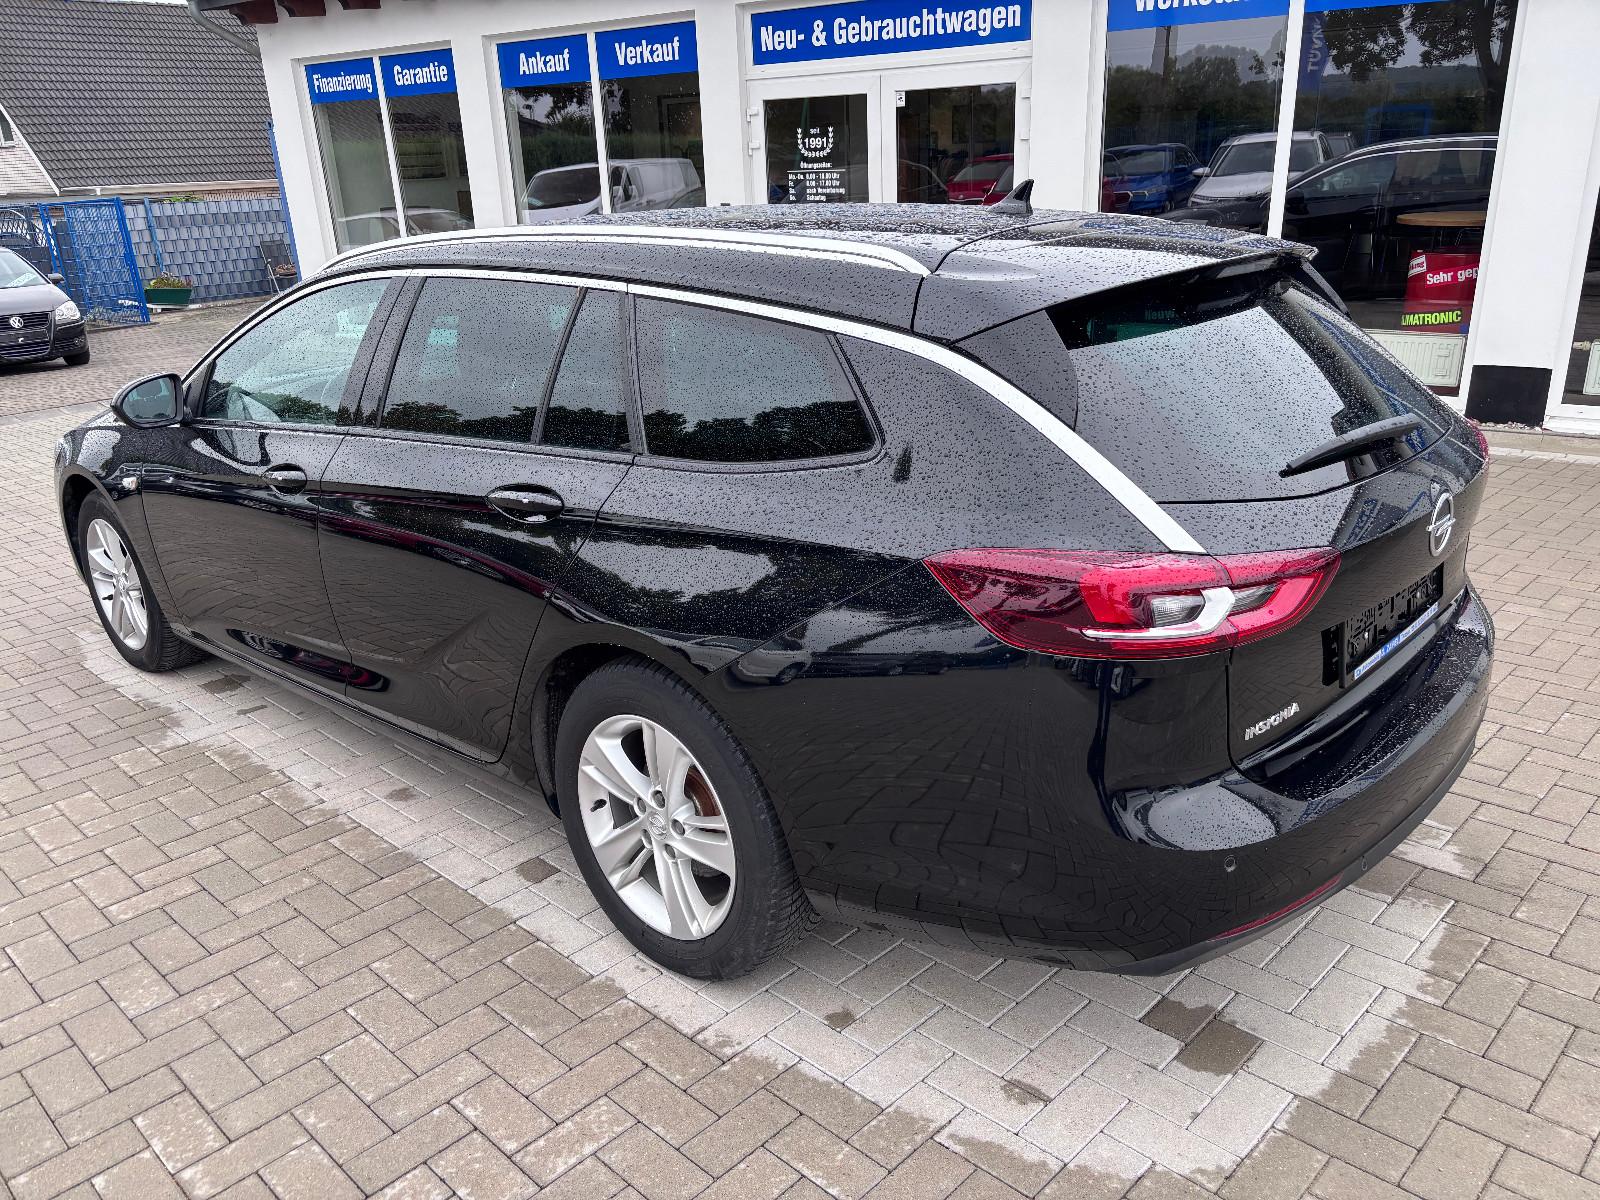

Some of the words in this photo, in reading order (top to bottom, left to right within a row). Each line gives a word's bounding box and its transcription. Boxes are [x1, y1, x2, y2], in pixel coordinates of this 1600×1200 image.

[760, 25, 805, 52] Neu-
[811, 19, 828, 47] &
[833, 3, 1021, 45] Gebrauchtwagen
[518, 47, 571, 75] Ankauf
[615, 36, 680, 66] Verkauf
[313, 71, 373, 95] Finanzierung
[393, 61, 448, 87] Garantie
[804, 137, 827, 148] 1991
[1426, 271, 1454, 285] Sehr
[1244, 702, 1300, 741] INSIGNIA
